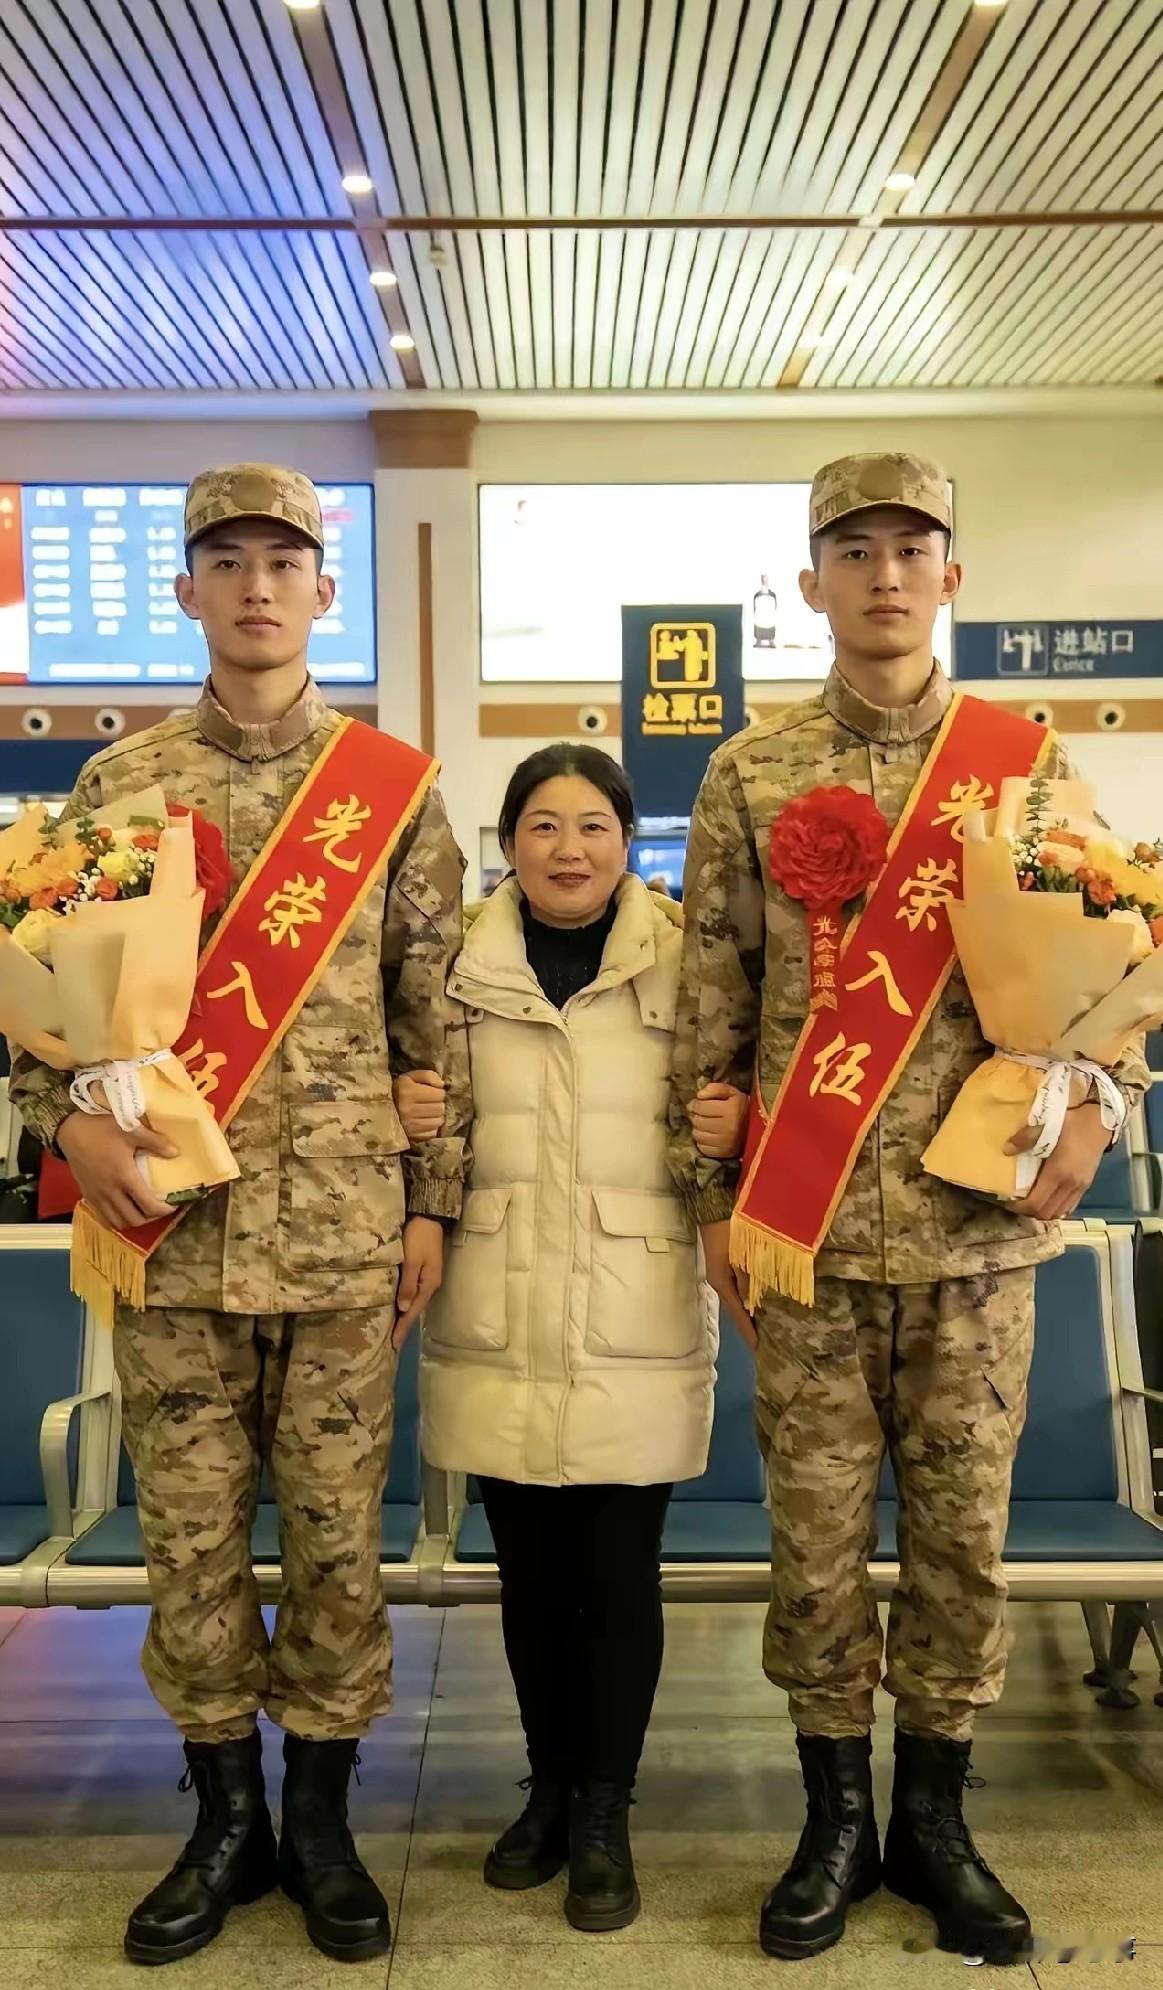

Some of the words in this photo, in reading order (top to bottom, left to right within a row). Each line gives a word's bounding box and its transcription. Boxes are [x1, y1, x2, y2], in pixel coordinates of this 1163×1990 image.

[1054, 627, 1134, 655] 进站口
[809, 773, 995, 1107] 光荣入伍
